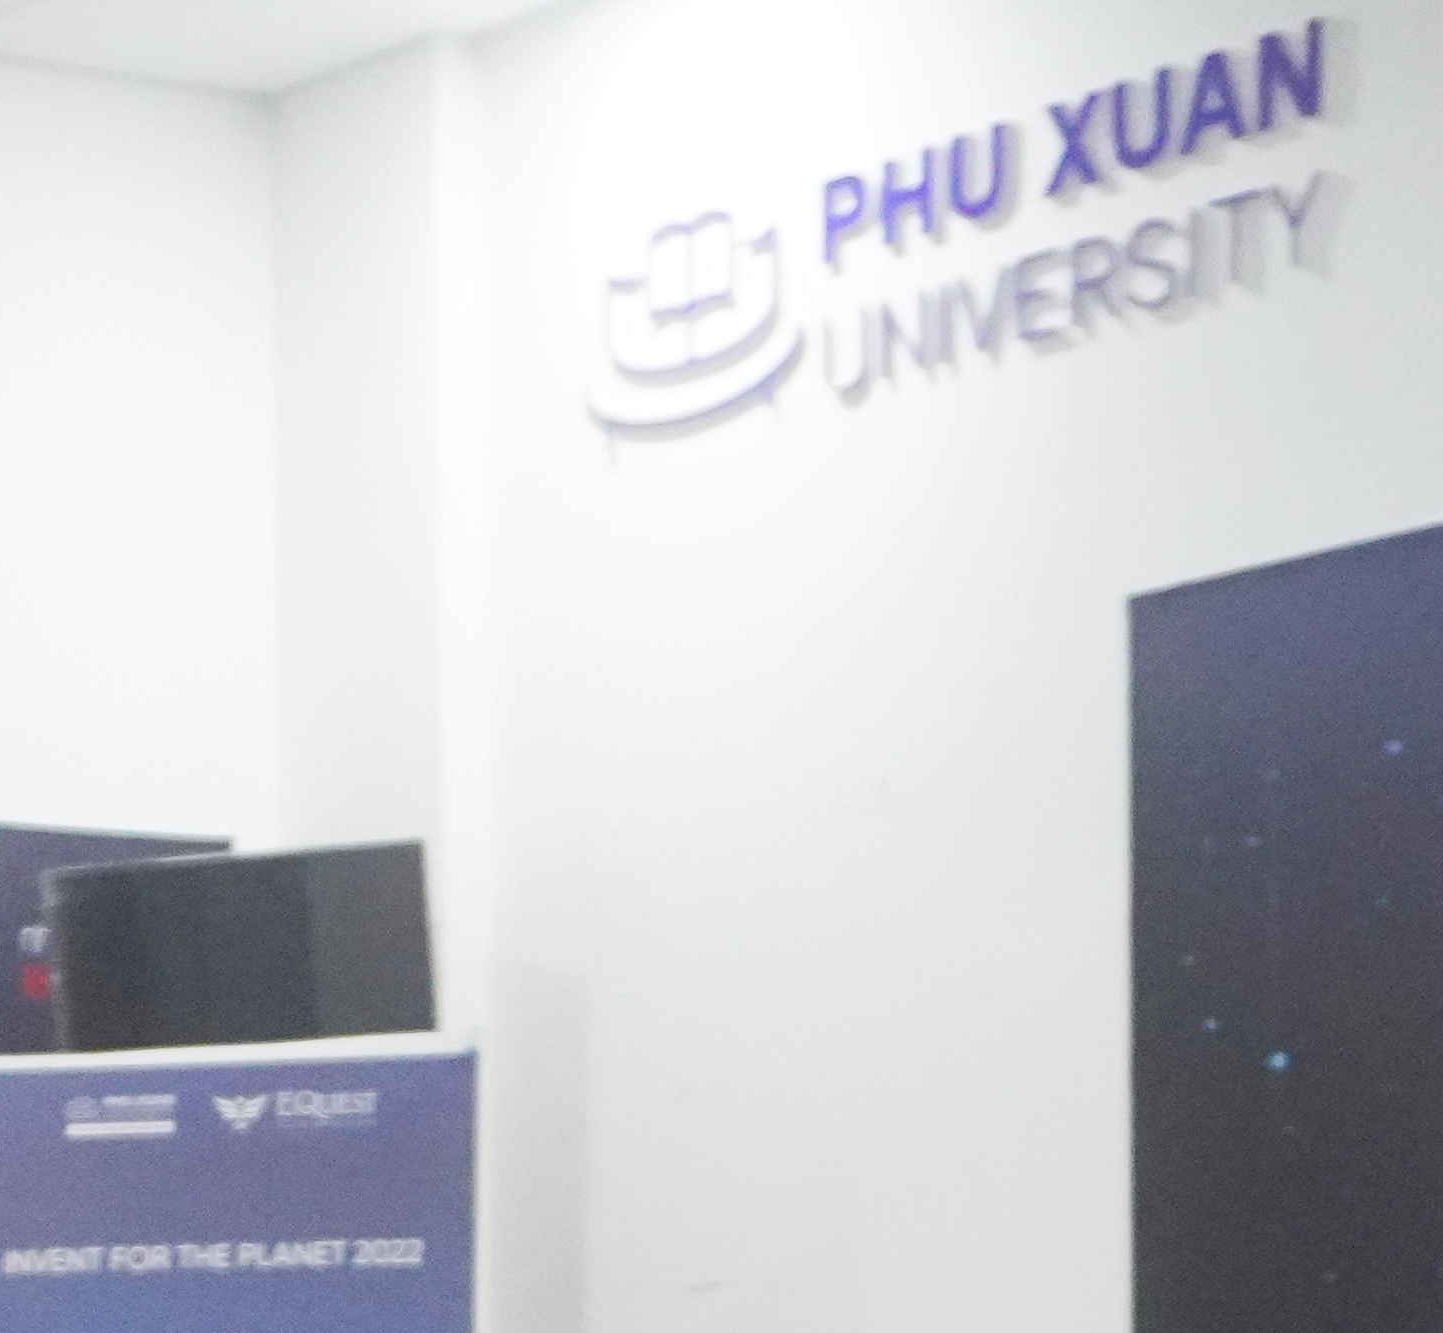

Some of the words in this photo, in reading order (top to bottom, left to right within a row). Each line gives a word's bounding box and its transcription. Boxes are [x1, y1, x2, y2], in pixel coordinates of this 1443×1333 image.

[822, 120, 1007, 265] PHU
[1044, 15, 1326, 198] XUAN
[822, 168, 1339, 406] UNIVERSITY
[1, 1246, 104, 1274] INVENT
[109, 1244, 172, 1272] FOR
[176, 1243, 231, 1269] THE
[237, 1240, 346, 1268] PLANET
[351, 1238, 425, 1266] 2022
